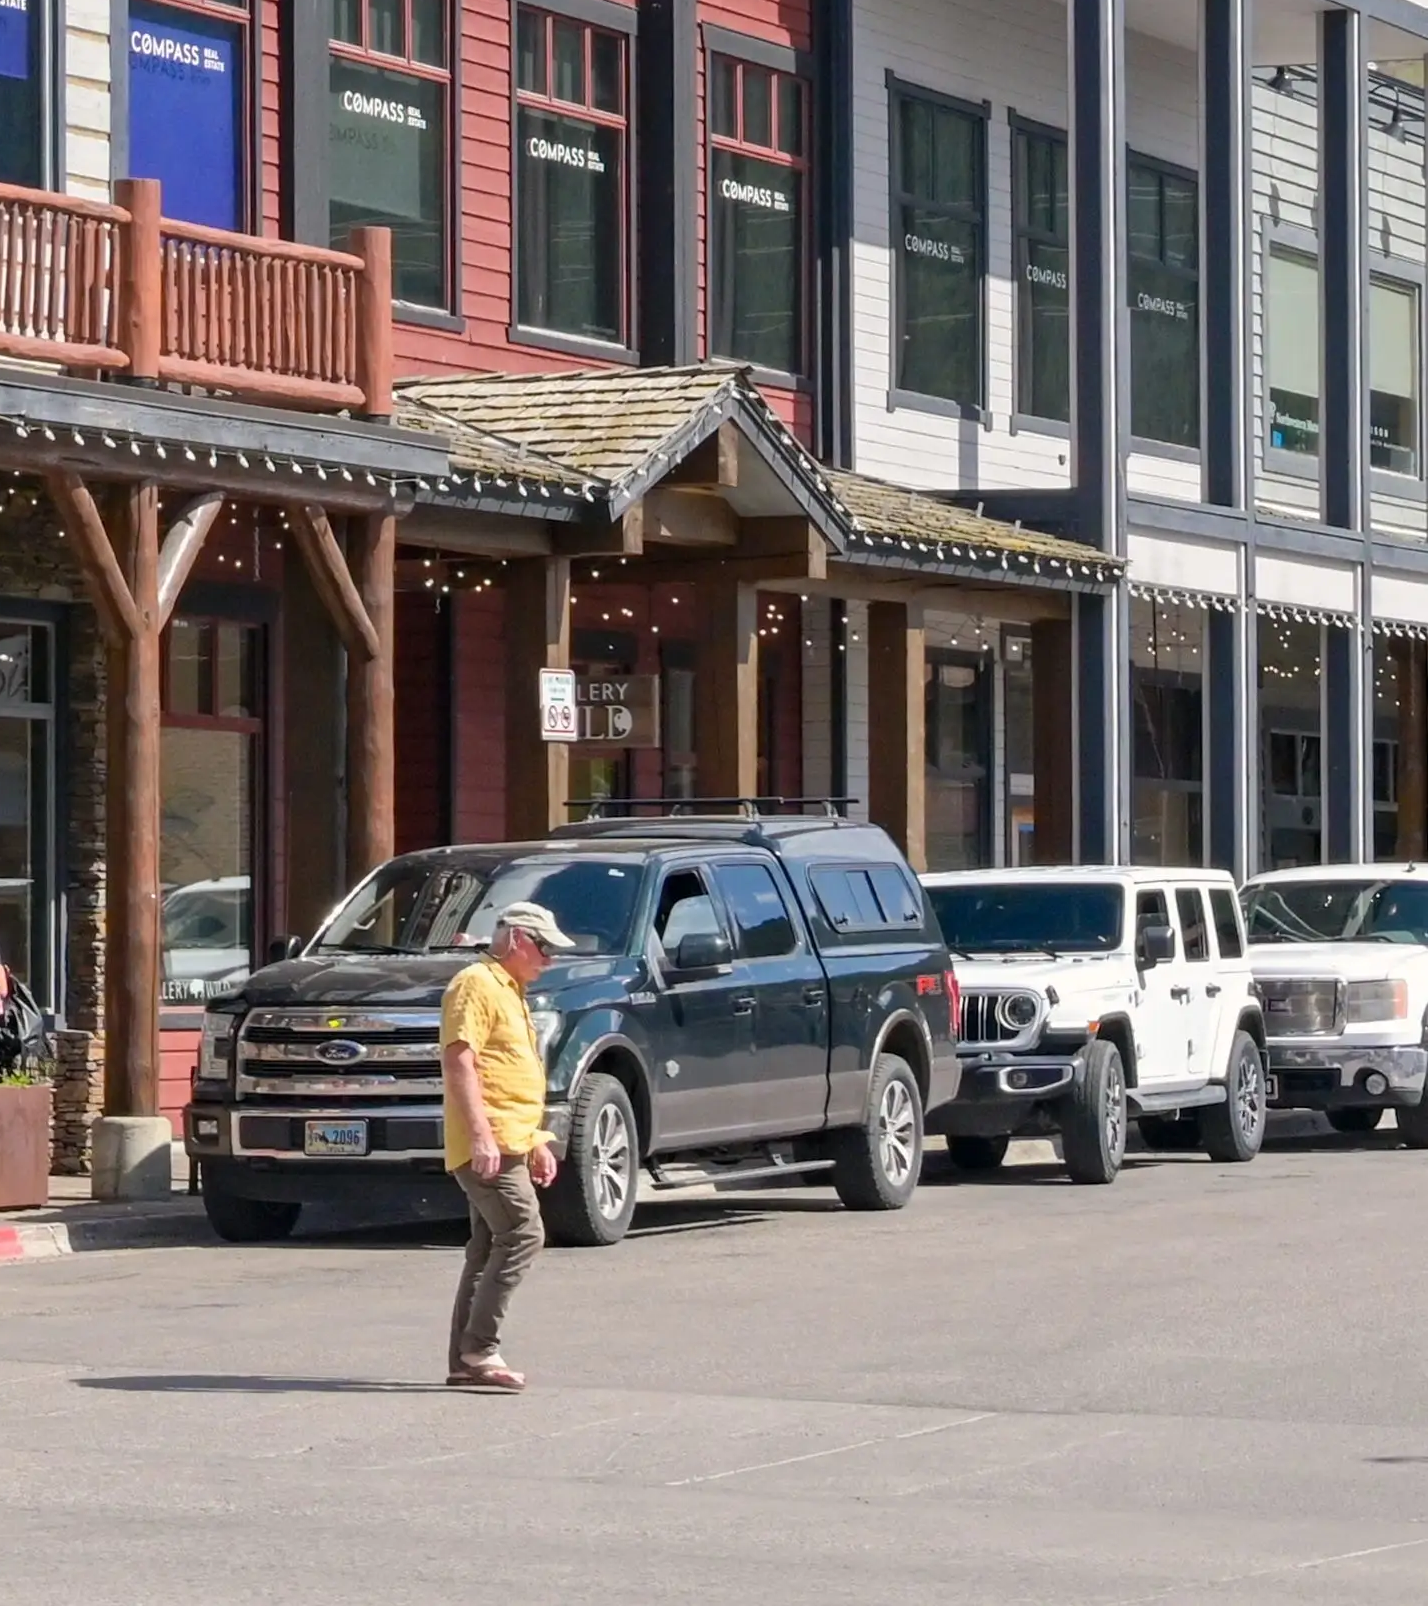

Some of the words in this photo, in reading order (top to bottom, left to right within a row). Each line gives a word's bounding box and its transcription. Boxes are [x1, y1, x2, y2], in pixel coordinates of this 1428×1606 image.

[131, 30, 200, 66] COMPASS
[344, 90, 404, 124] COMPASS
[530, 137, 585, 168] COMPASS
[722, 179, 772, 208] COMPASS
[905, 234, 949, 261] COMPASS
[1026, 264, 1067, 289] COMPASS
